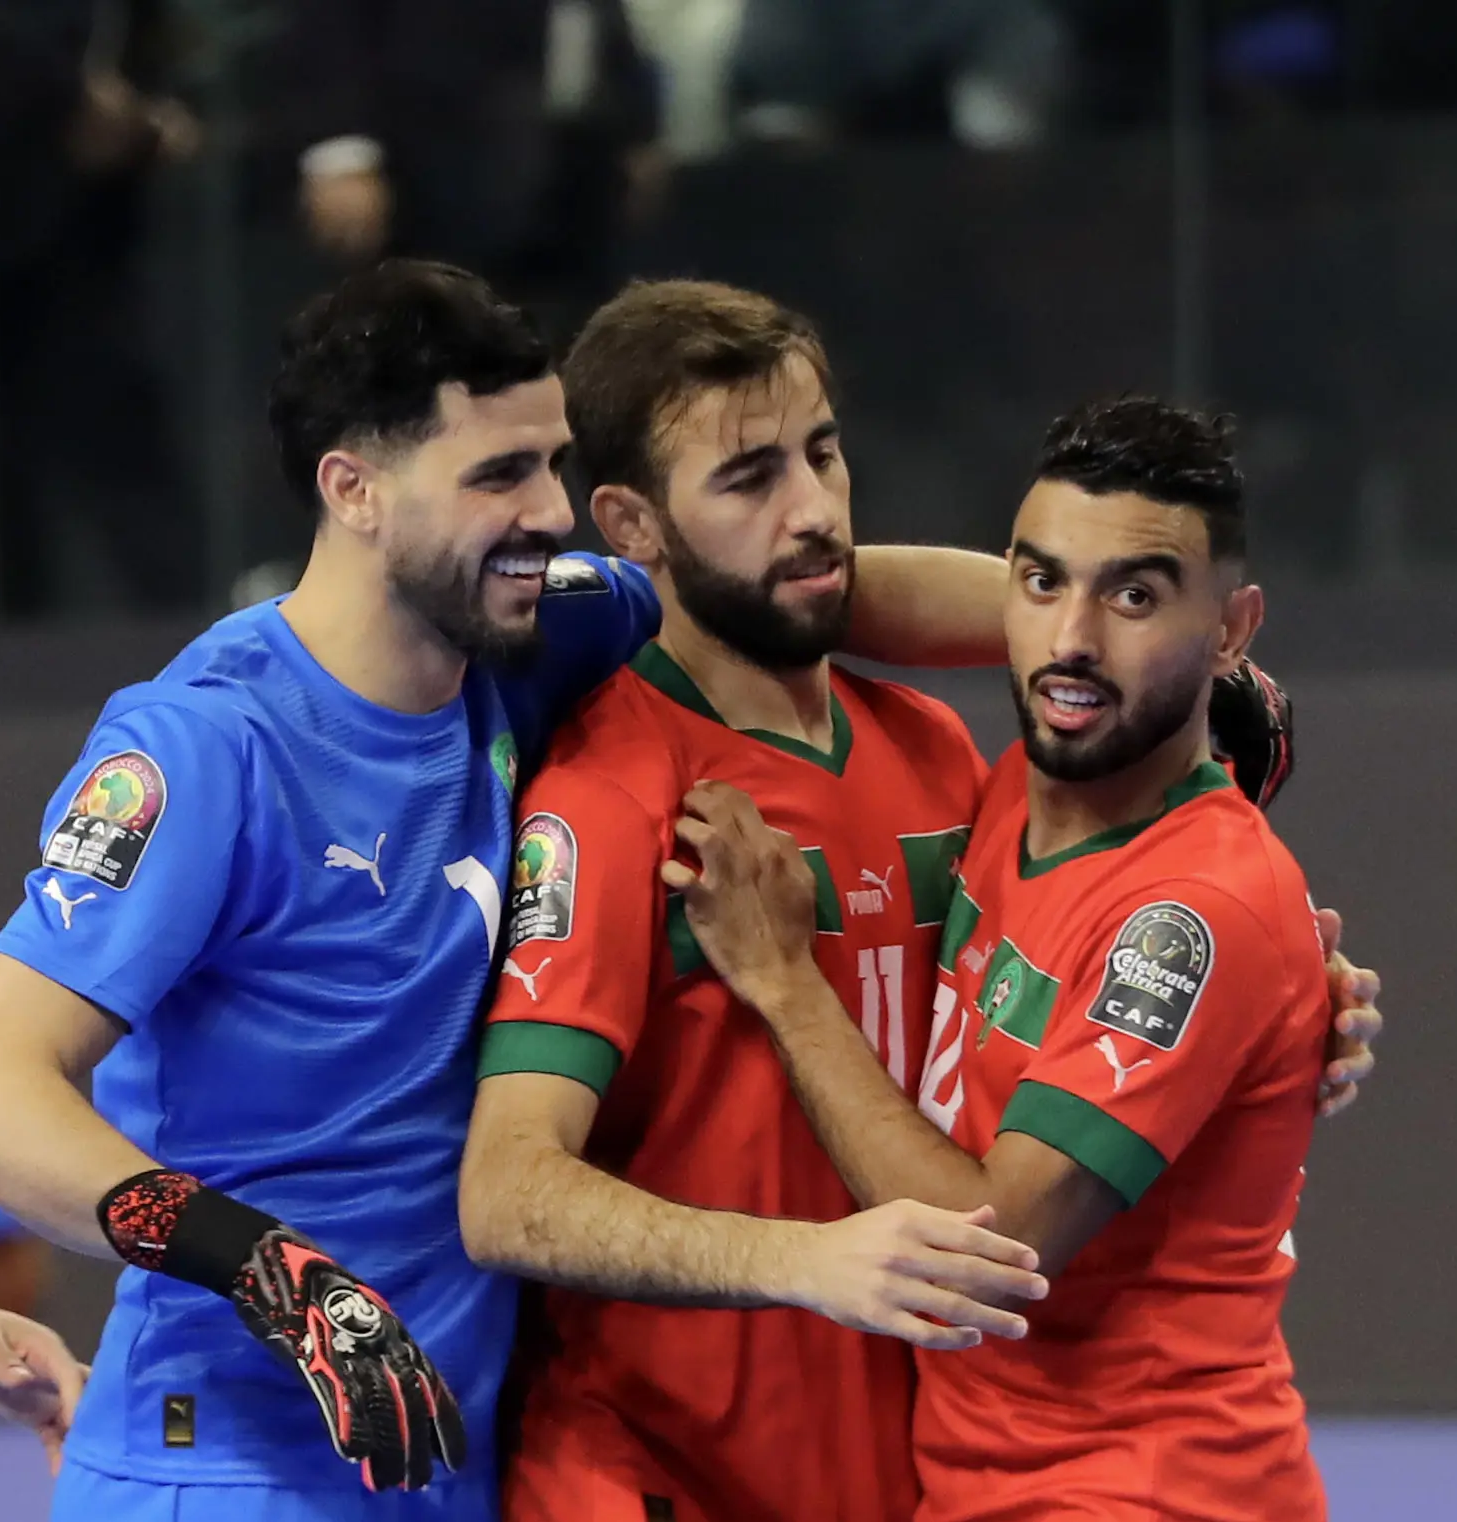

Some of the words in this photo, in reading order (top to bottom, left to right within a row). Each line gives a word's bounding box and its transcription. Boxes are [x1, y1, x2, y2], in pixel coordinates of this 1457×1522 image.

[72, 817, 127, 840] CAF
[443, 855, 501, 962] 1
[1112, 947, 1197, 995] Celebrate
[1116, 970, 1174, 999] Africa
[858, 945, 907, 1092] 11
[1105, 999, 1165, 1030] CAF
